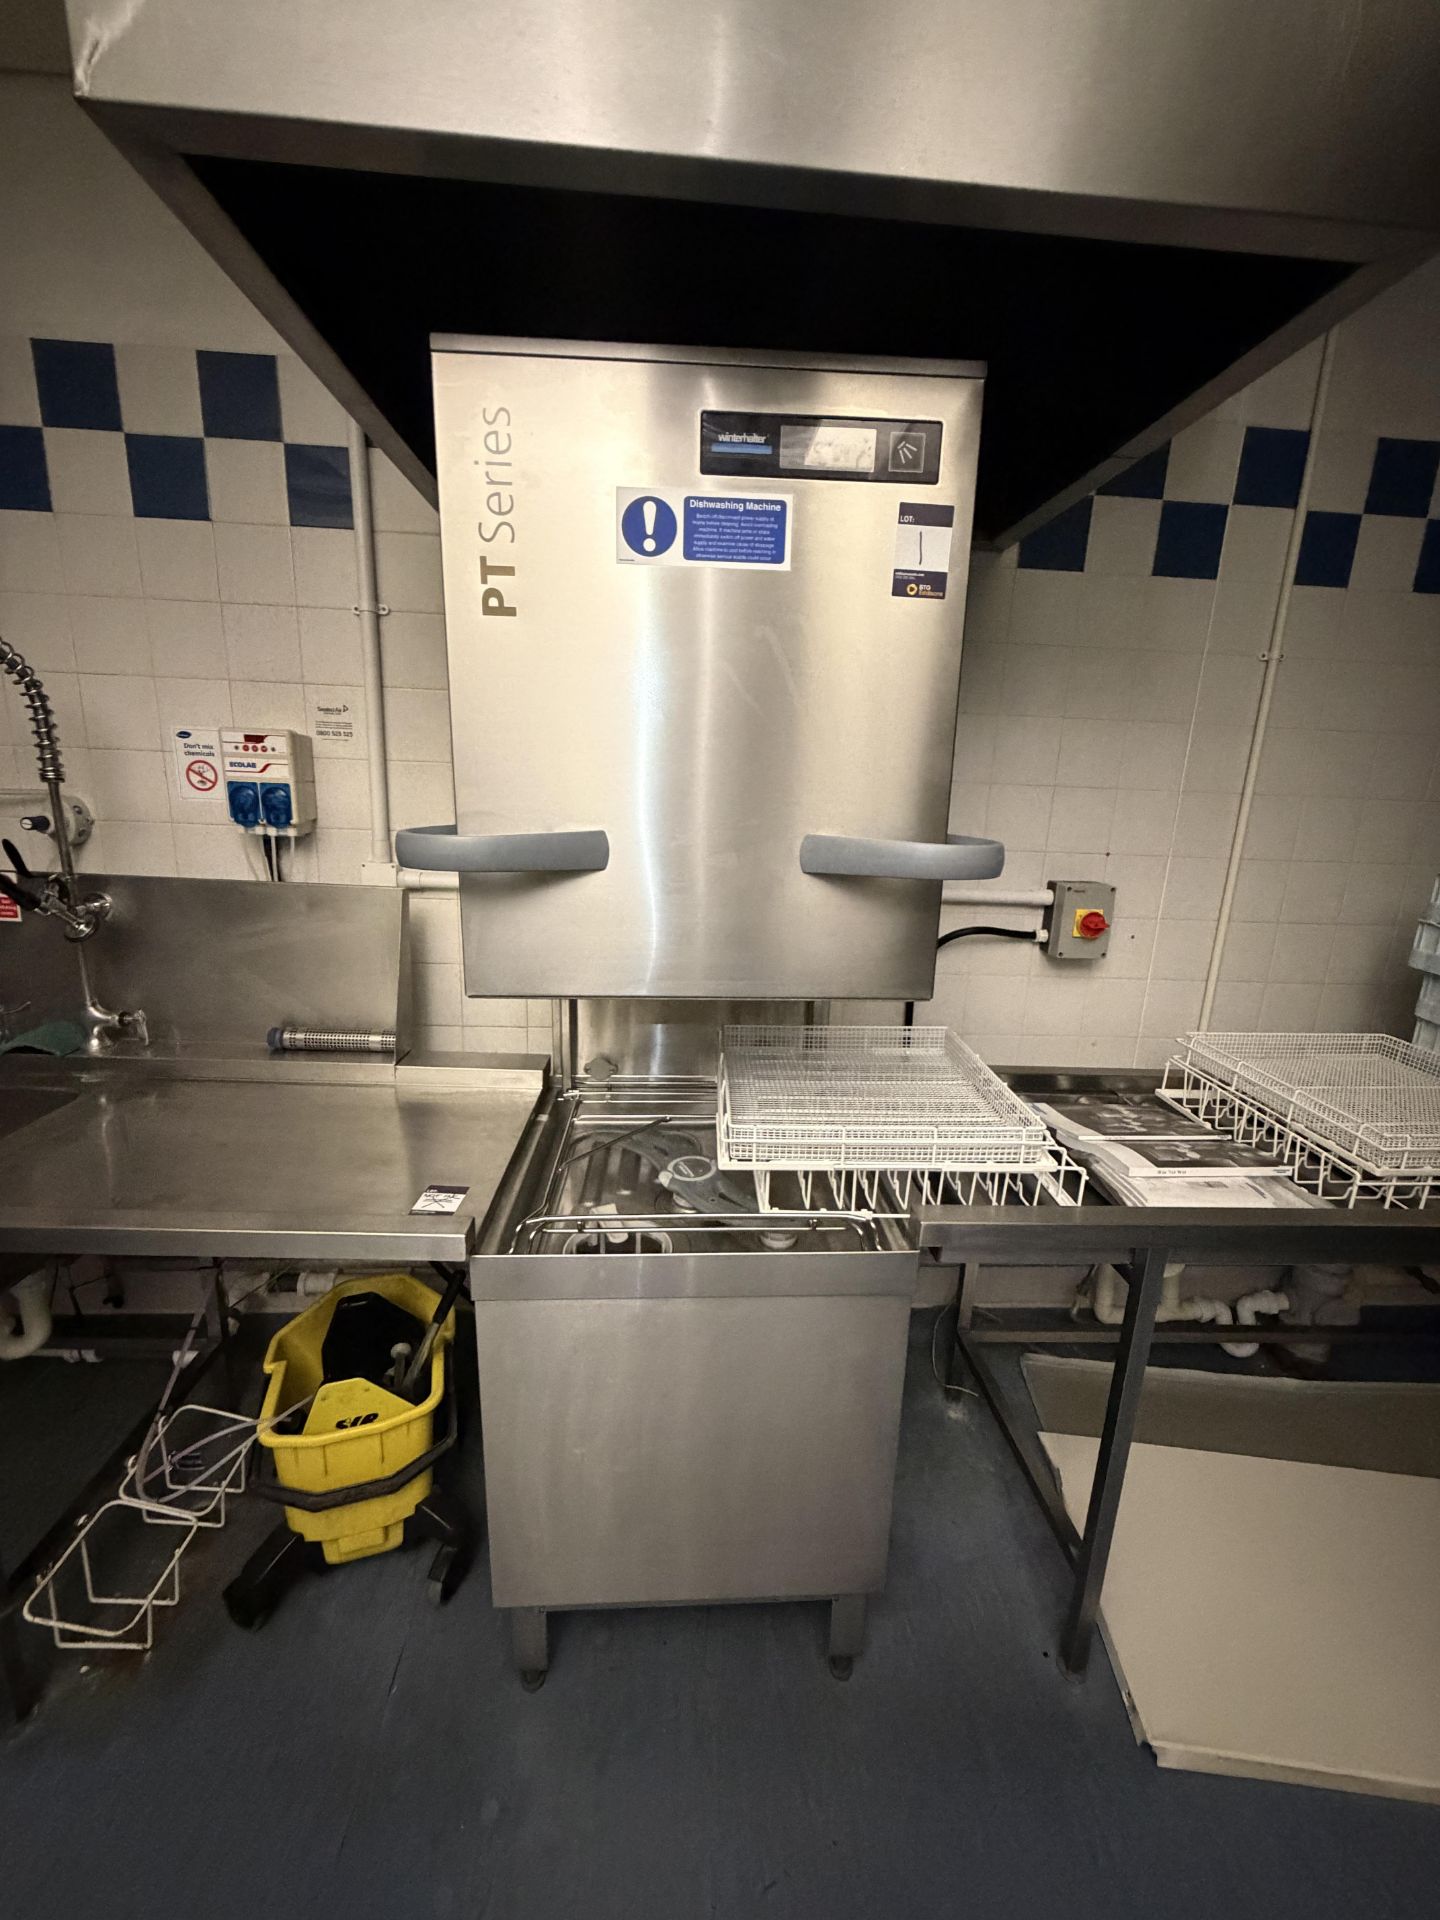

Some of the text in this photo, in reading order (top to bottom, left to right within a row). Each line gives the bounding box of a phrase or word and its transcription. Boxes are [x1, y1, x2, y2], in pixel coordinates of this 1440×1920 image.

[718, 432, 767, 443] winterhalter
[474, 406, 517, 617] PT Series
[689, 499, 782, 512] Dishwashing Machine
[229, 761, 257, 769] ECOLAB
